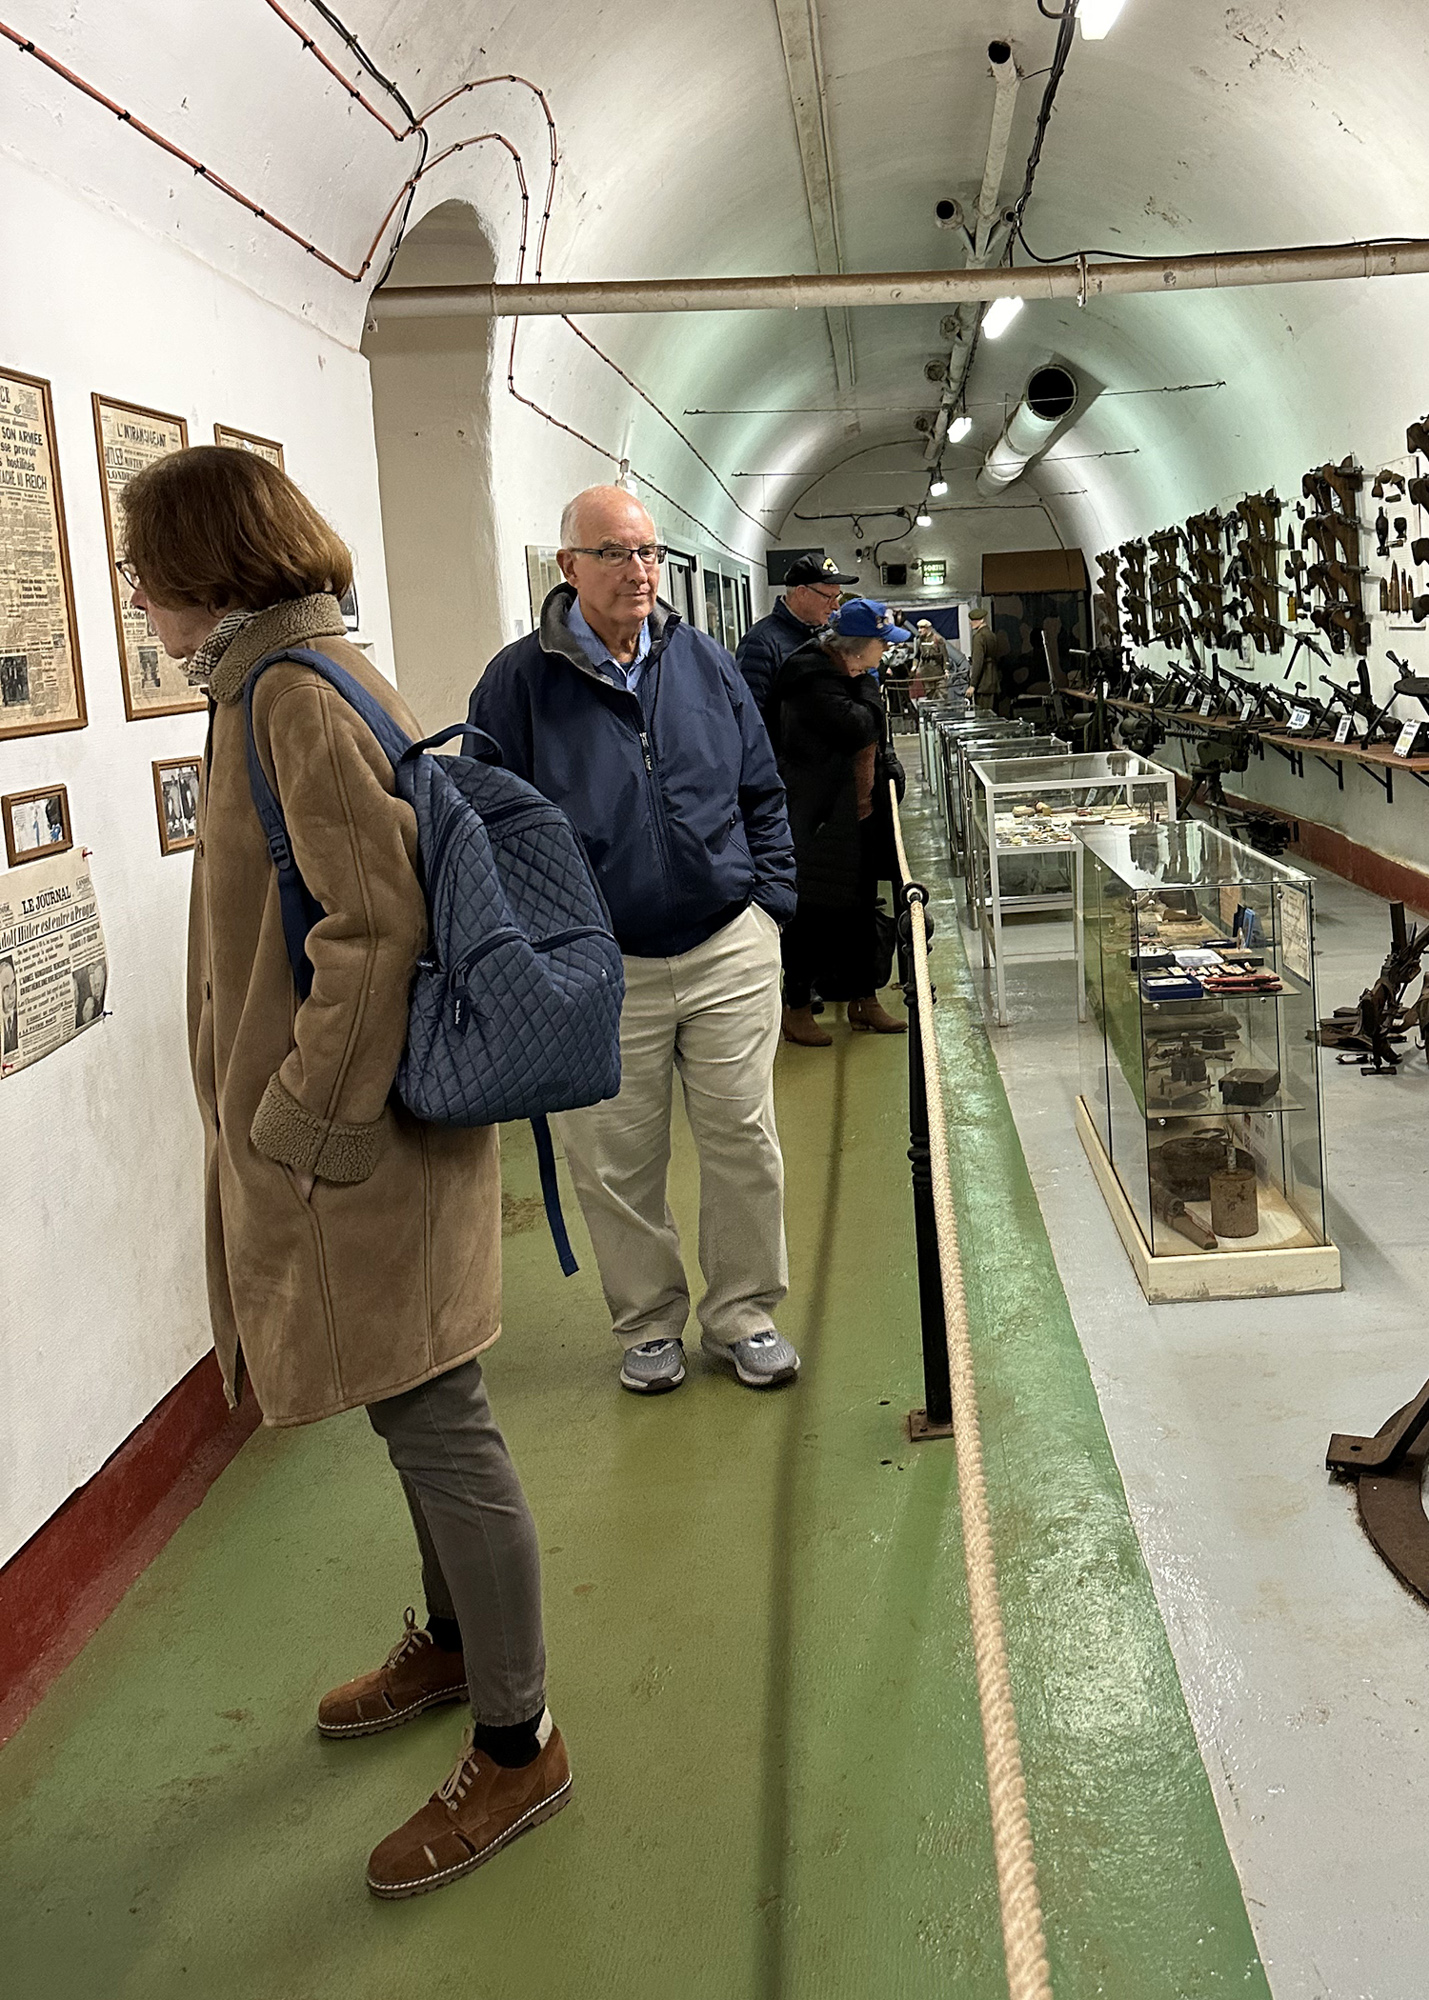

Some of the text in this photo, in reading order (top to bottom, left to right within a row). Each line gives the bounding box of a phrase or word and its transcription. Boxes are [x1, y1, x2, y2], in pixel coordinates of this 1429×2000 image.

[1, 426, 16, 441] SON
[25, 473, 47, 490] REICH
[21, 898, 35, 914] LE
[36, 886, 71, 910] JOURNAL
[18, 922, 40, 942] Hitler
